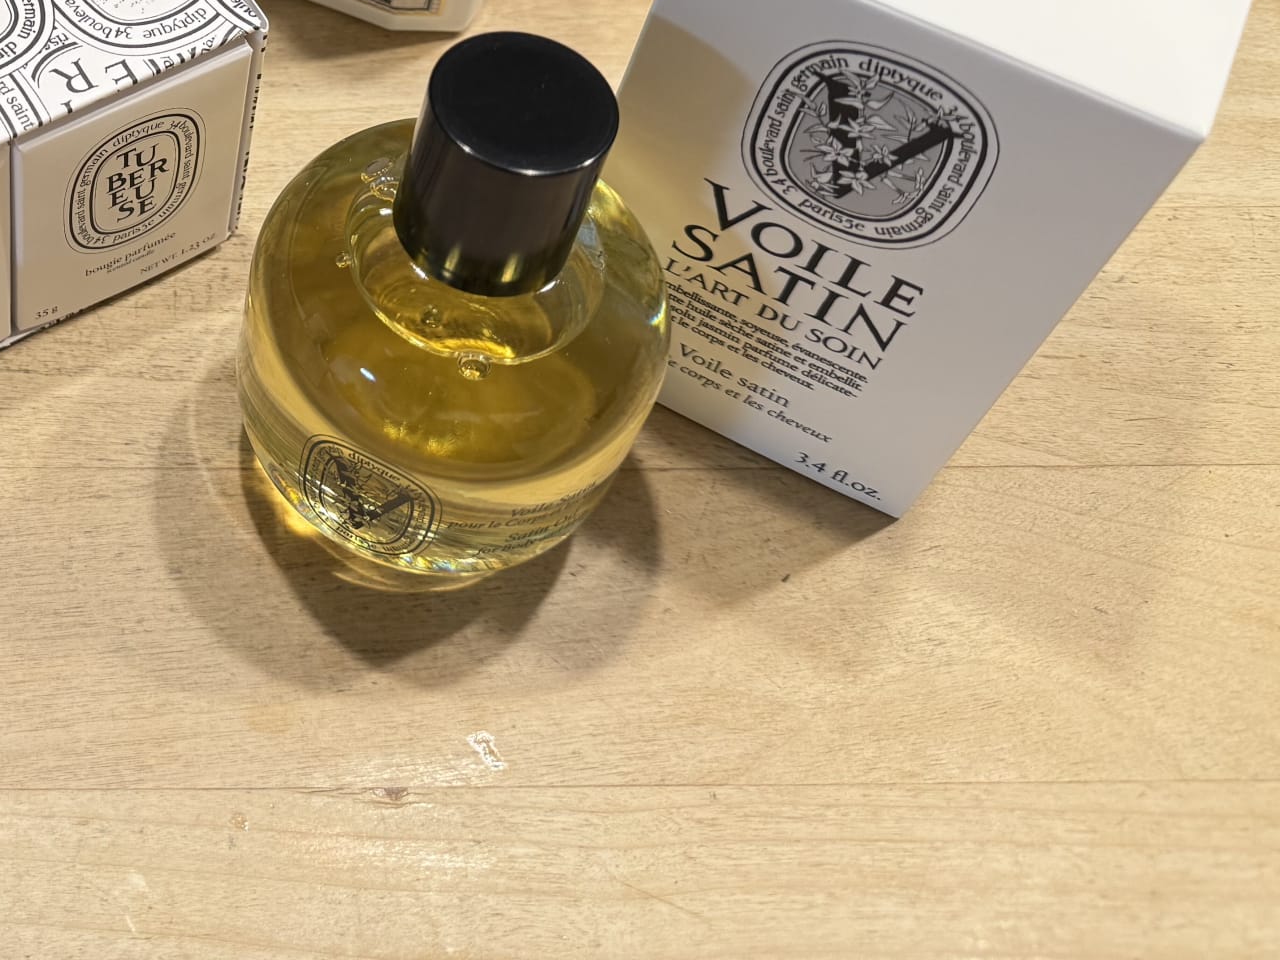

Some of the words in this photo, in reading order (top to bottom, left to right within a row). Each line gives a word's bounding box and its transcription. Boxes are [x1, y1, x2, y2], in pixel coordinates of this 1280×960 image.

[142, 7, 207, 39] diptyque
[112, 120, 166, 148] diptyque
[116, 142, 160, 170] TU
[106, 157, 170, 194] BER
[108, 177, 158, 208] EU
[117, 195, 156, 223] SE
[85, 256, 122, 277] bougie
[123, 232, 177, 263] parfumée
[703, 176, 924, 318] VOILE
[139, 262, 160, 275] NET
[671, 223, 908, 352] SATIN
[34, 308, 49, 320] 35
[691, 324, 725, 347] corps
[727, 342, 740, 354] et
[756, 304, 802, 332] DU
[804, 328, 883, 370] SOIN
[680, 343, 733, 379] Voile
[736, 374, 790, 409] satin
[680, 366, 723, 391] corps
[725, 386, 740, 399] et
[743, 394, 765, 410] les
[766, 409, 833, 443] cheveux
[348, 452, 401, 482] diptyque
[793, 451, 826, 473] 3.4
